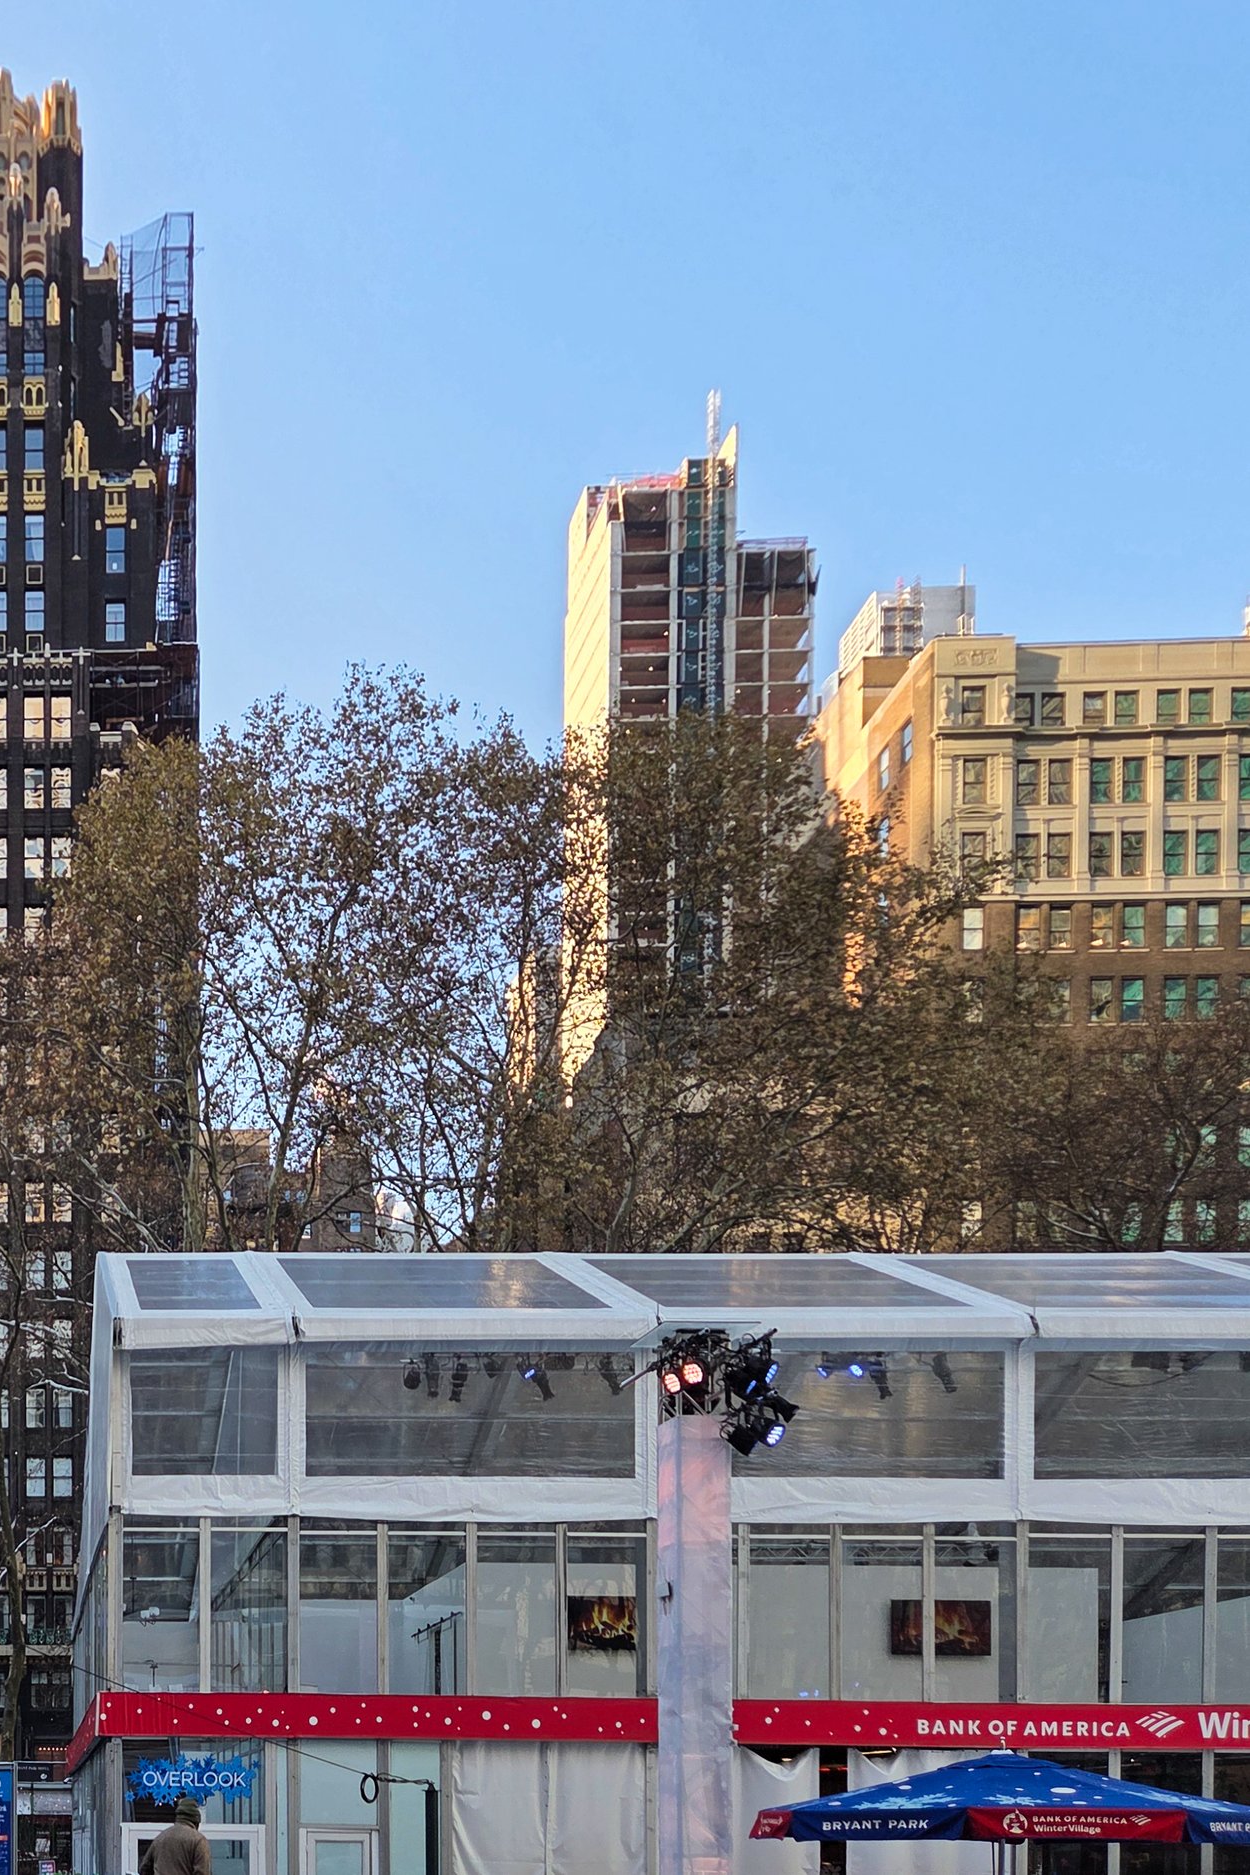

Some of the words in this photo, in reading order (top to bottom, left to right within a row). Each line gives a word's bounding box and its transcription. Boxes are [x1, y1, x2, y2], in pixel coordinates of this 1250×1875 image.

[917, 1719, 981, 1735] BANK
[988, 1719, 1018, 1736] OF
[1023, 1720, 1131, 1737] AMERICA
[142, 1771, 247, 1787] OVERLOOK
[822, 1819, 882, 1831] BRYANT
[888, 1819, 930, 1830] PARK
[1032, 1815, 1062, 1823] BANK
[1064, 1815, 1077, 1823] OF
[1079, 1815, 1128, 1825] AMERICA
[1033, 1824, 1068, 1833] Winter
[1068, 1824, 1102, 1835] Village
[1210, 1822, 1244, 1832] BRYANT
